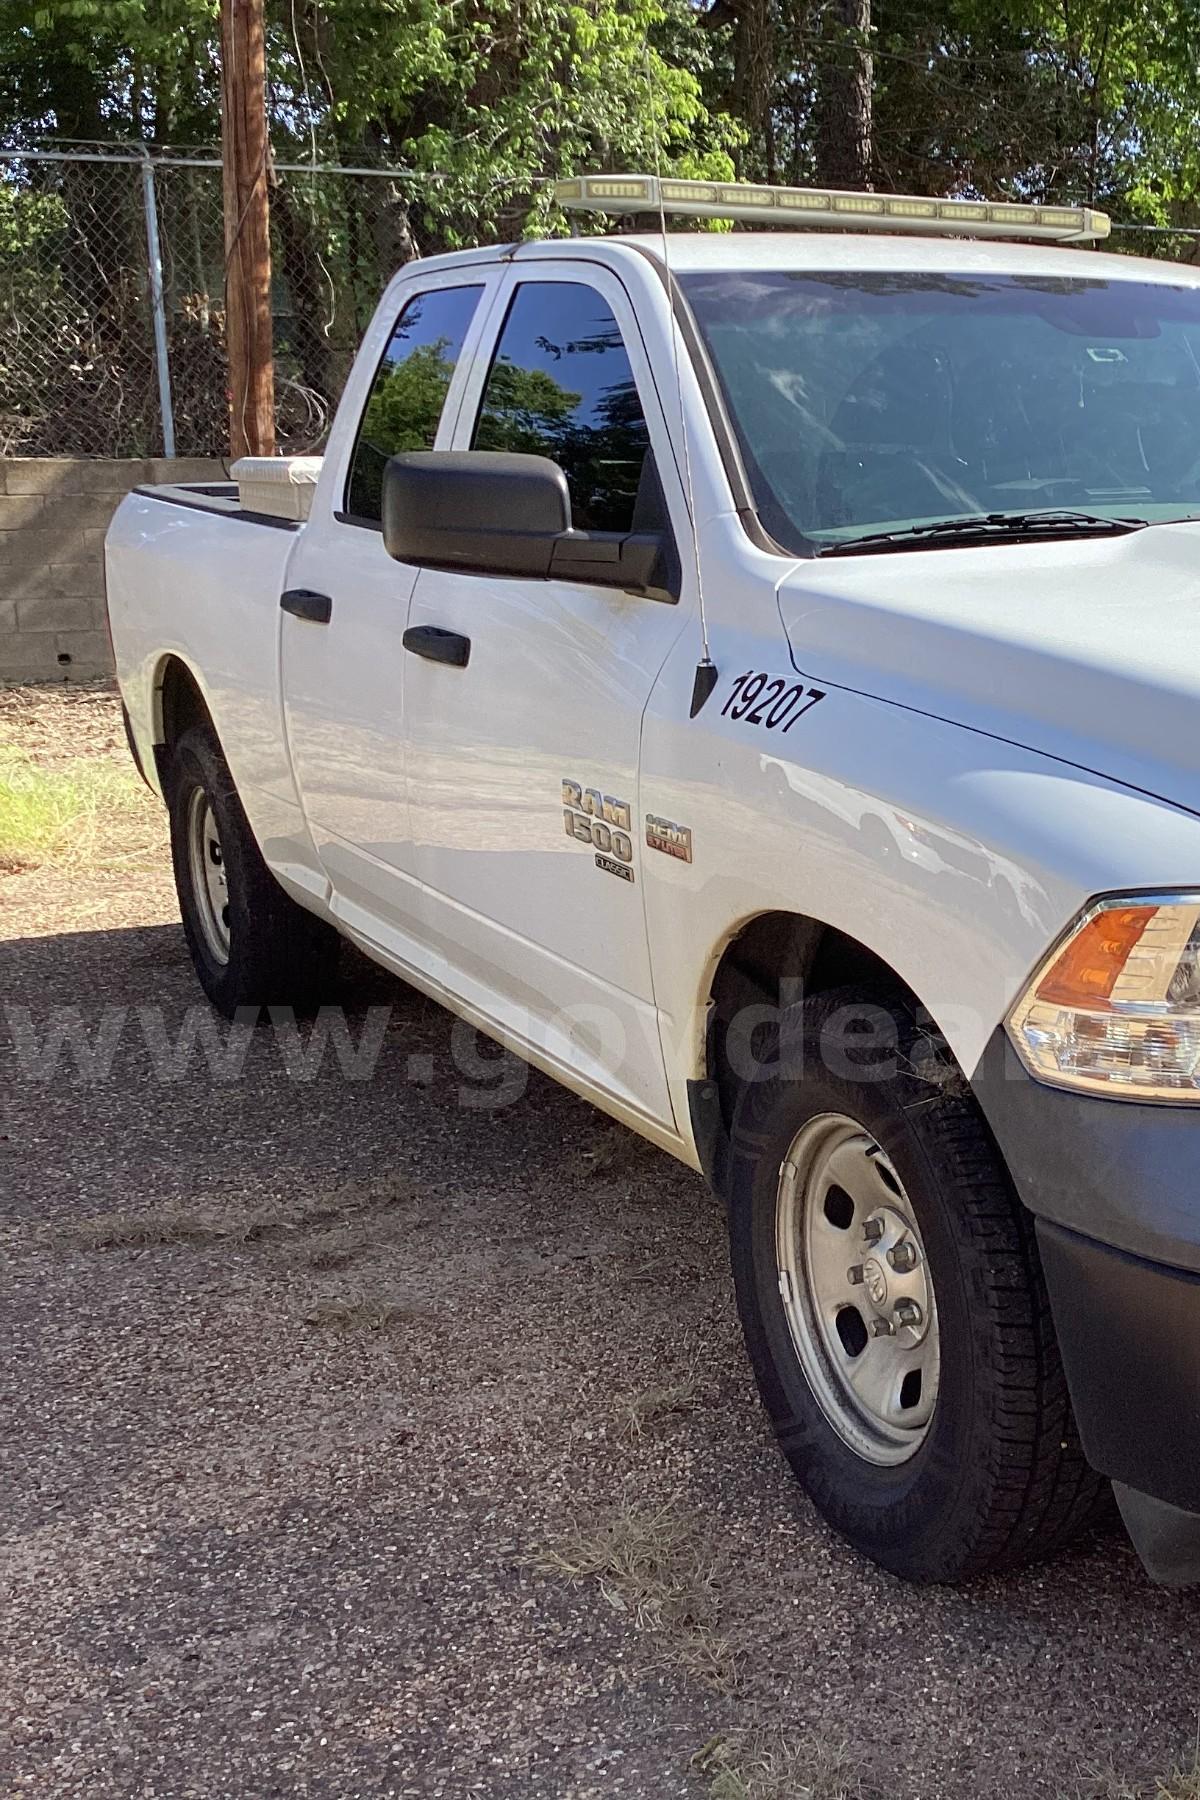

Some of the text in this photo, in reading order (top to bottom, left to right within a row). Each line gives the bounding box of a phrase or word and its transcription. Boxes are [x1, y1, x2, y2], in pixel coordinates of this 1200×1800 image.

[721, 670, 827, 733] 19207
[562, 778, 631, 832] RAM
[563, 808, 633, 862] 1500
[595, 854, 633, 882] CLASSIC
